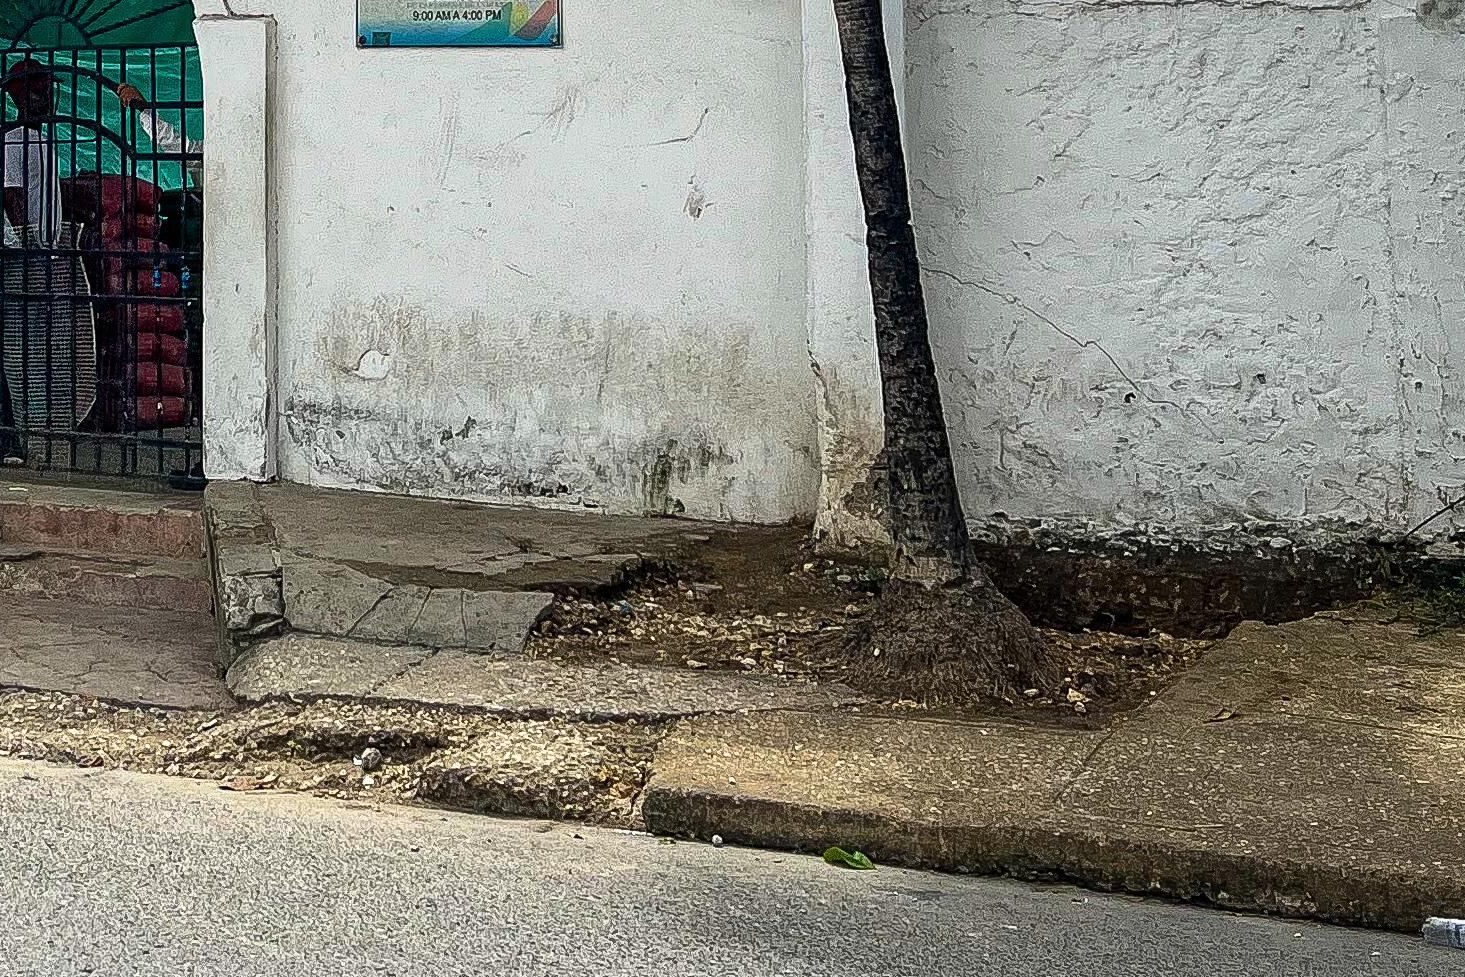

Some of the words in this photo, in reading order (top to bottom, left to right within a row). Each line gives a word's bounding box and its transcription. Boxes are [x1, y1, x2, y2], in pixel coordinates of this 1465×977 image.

[413, 10, 433, 21] 9:00
[435, 10, 450, 20] AM
[453, 11, 460, 20] A
[462, 10, 482, 20] 4:00
[486, 10, 501, 20] PM
